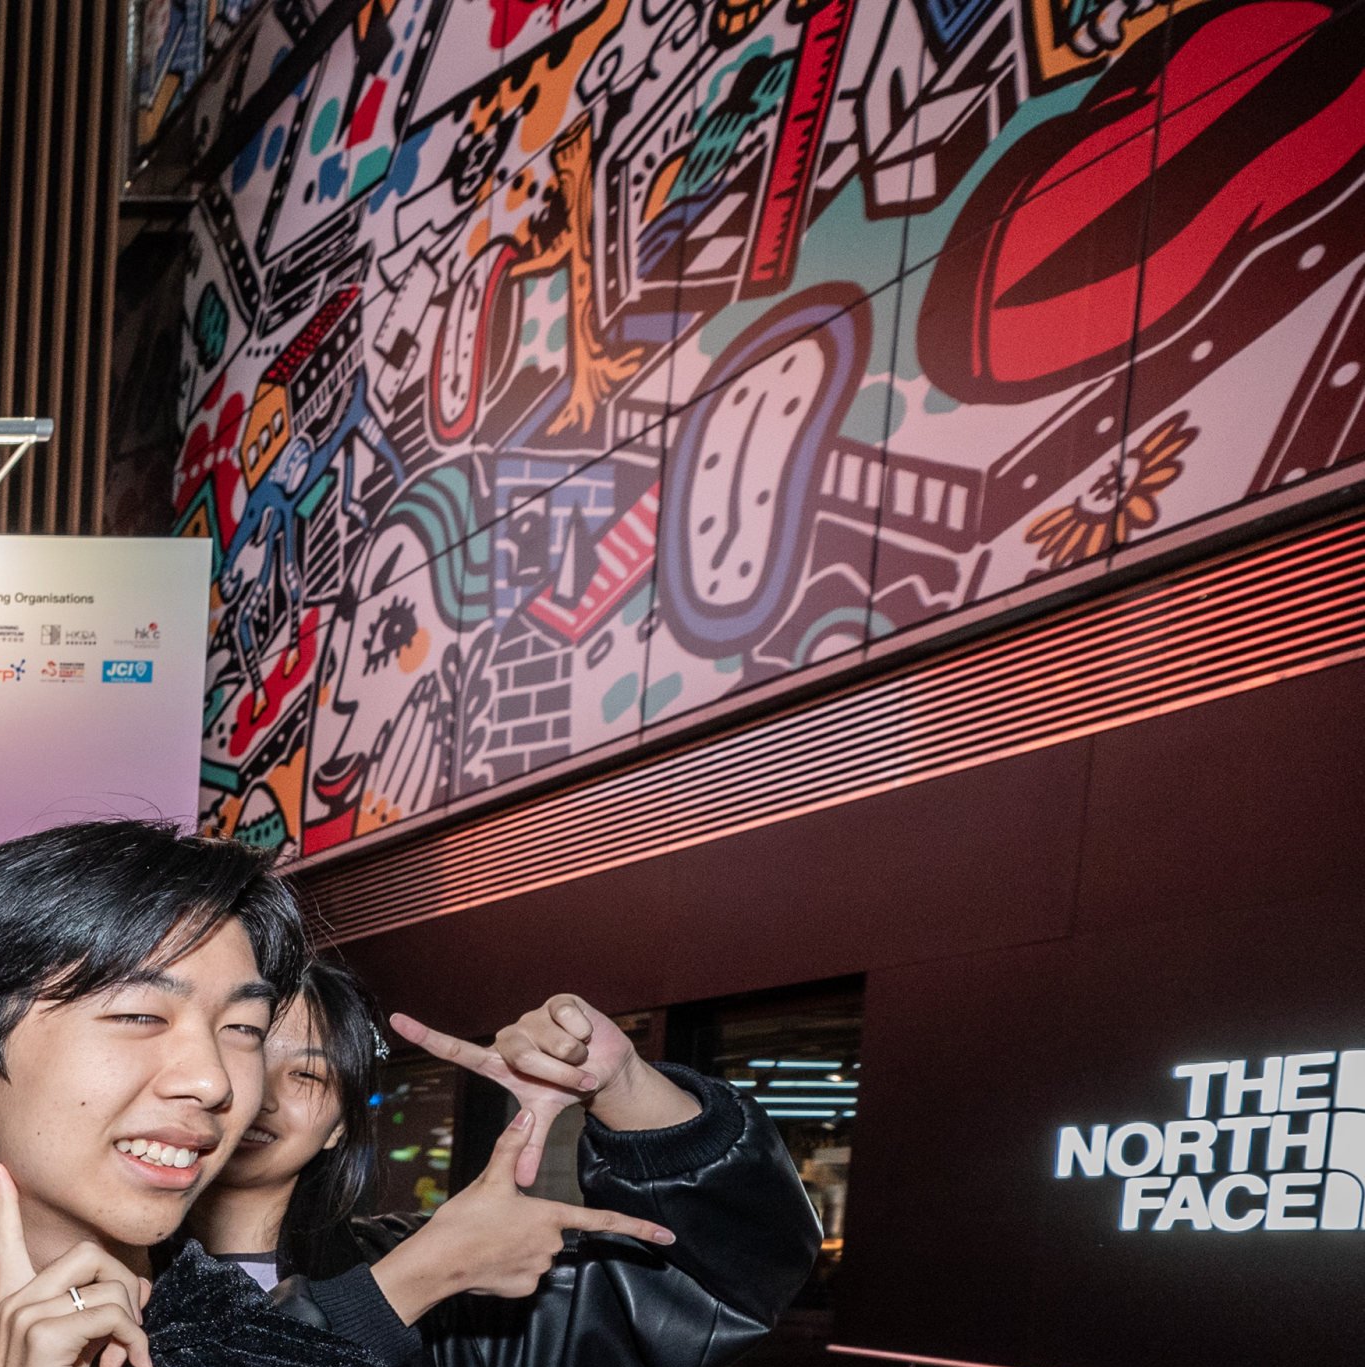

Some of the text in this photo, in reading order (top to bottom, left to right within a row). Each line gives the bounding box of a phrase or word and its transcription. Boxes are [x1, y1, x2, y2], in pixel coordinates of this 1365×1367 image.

[15, 592, 94, 605] Organisations
[107, 663, 134, 676] JCI
[1174, 1051, 1336, 1118] THE
[1054, 1112, 1329, 1179] NORTH
[1120, 1172, 1322, 1232] FACE
